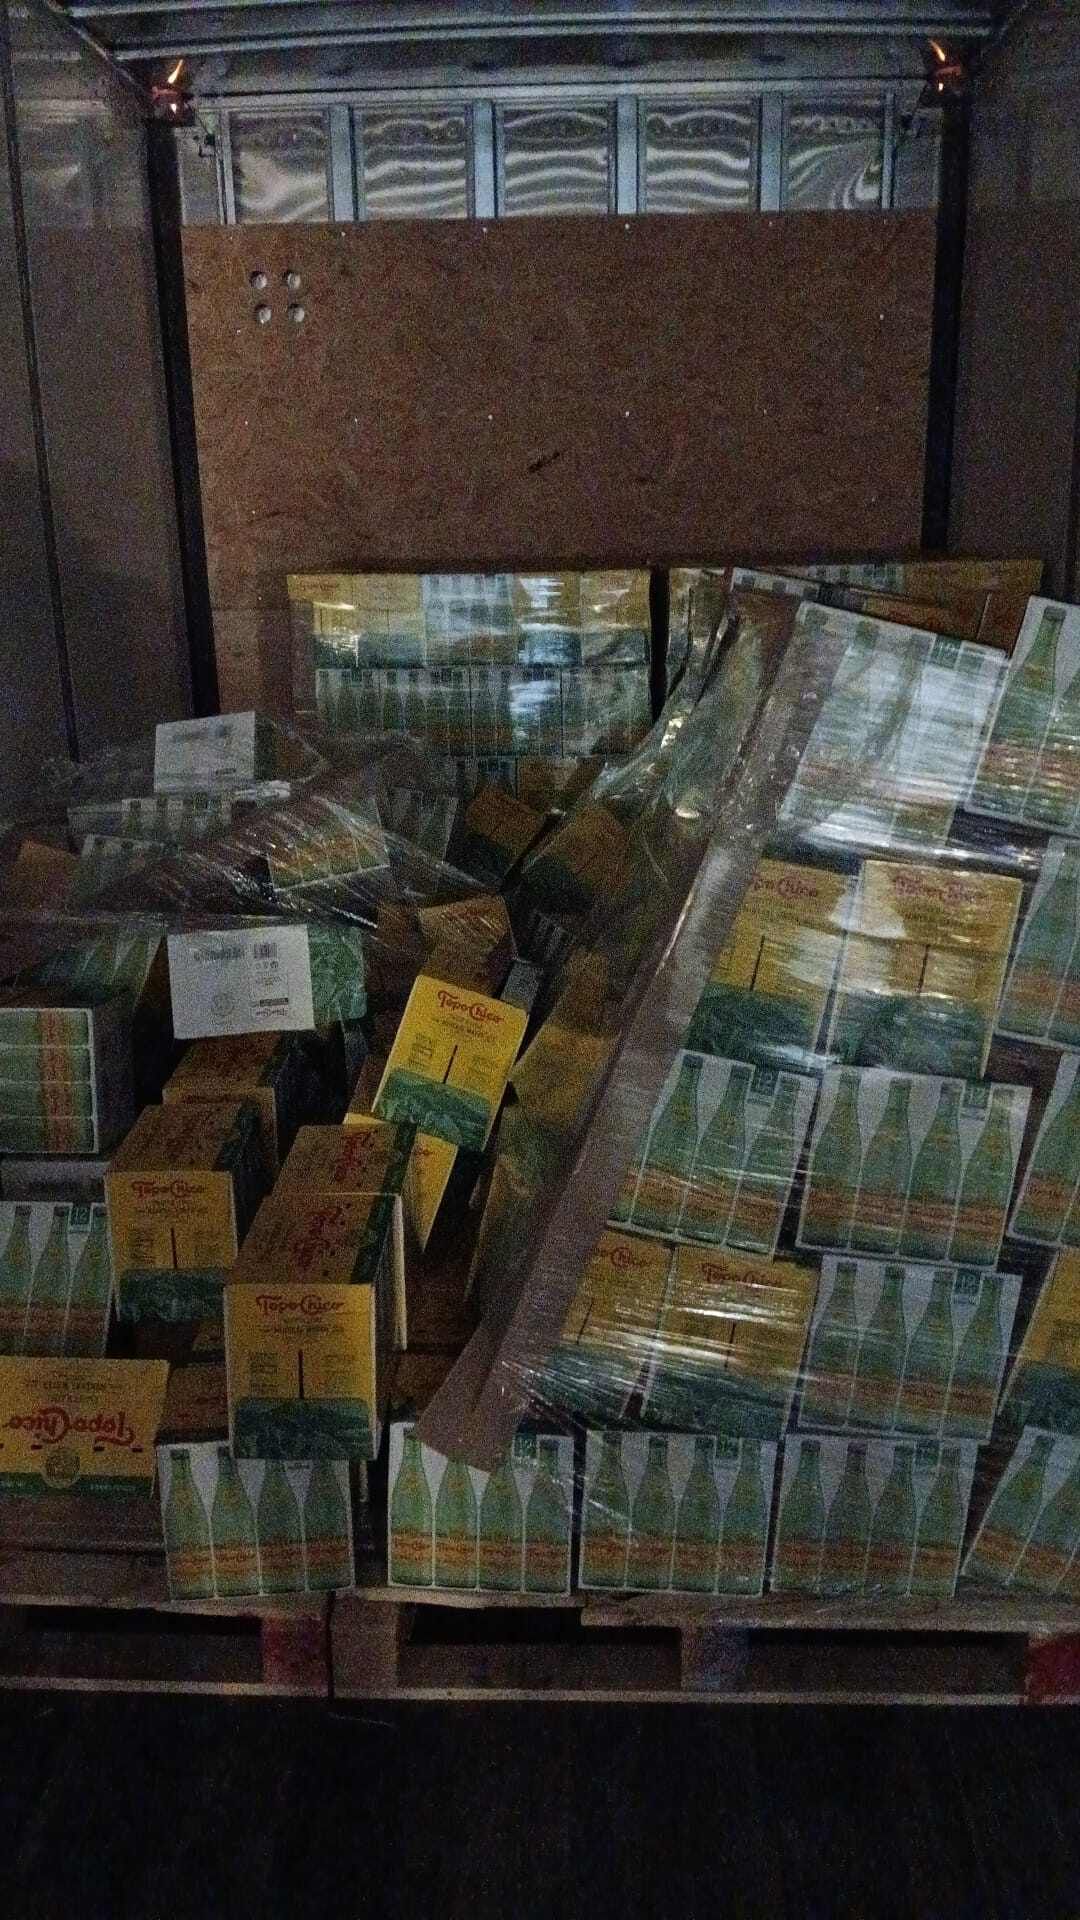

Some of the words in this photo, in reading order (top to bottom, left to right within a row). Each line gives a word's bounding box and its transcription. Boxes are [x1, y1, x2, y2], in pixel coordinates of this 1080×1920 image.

[437, 990, 469, 1011] Topo
[469, 1002, 505, 1024] Chico
[131, 1180, 170, 1199] Topo
[170, 1180, 207, 1199] Chico
[256, 1293, 301, 1316] Topo
[300, 1293, 345, 1316] Chico
[1, 1407, 71, 1445] Chico
[71, 1411, 136, 1447] Topo
